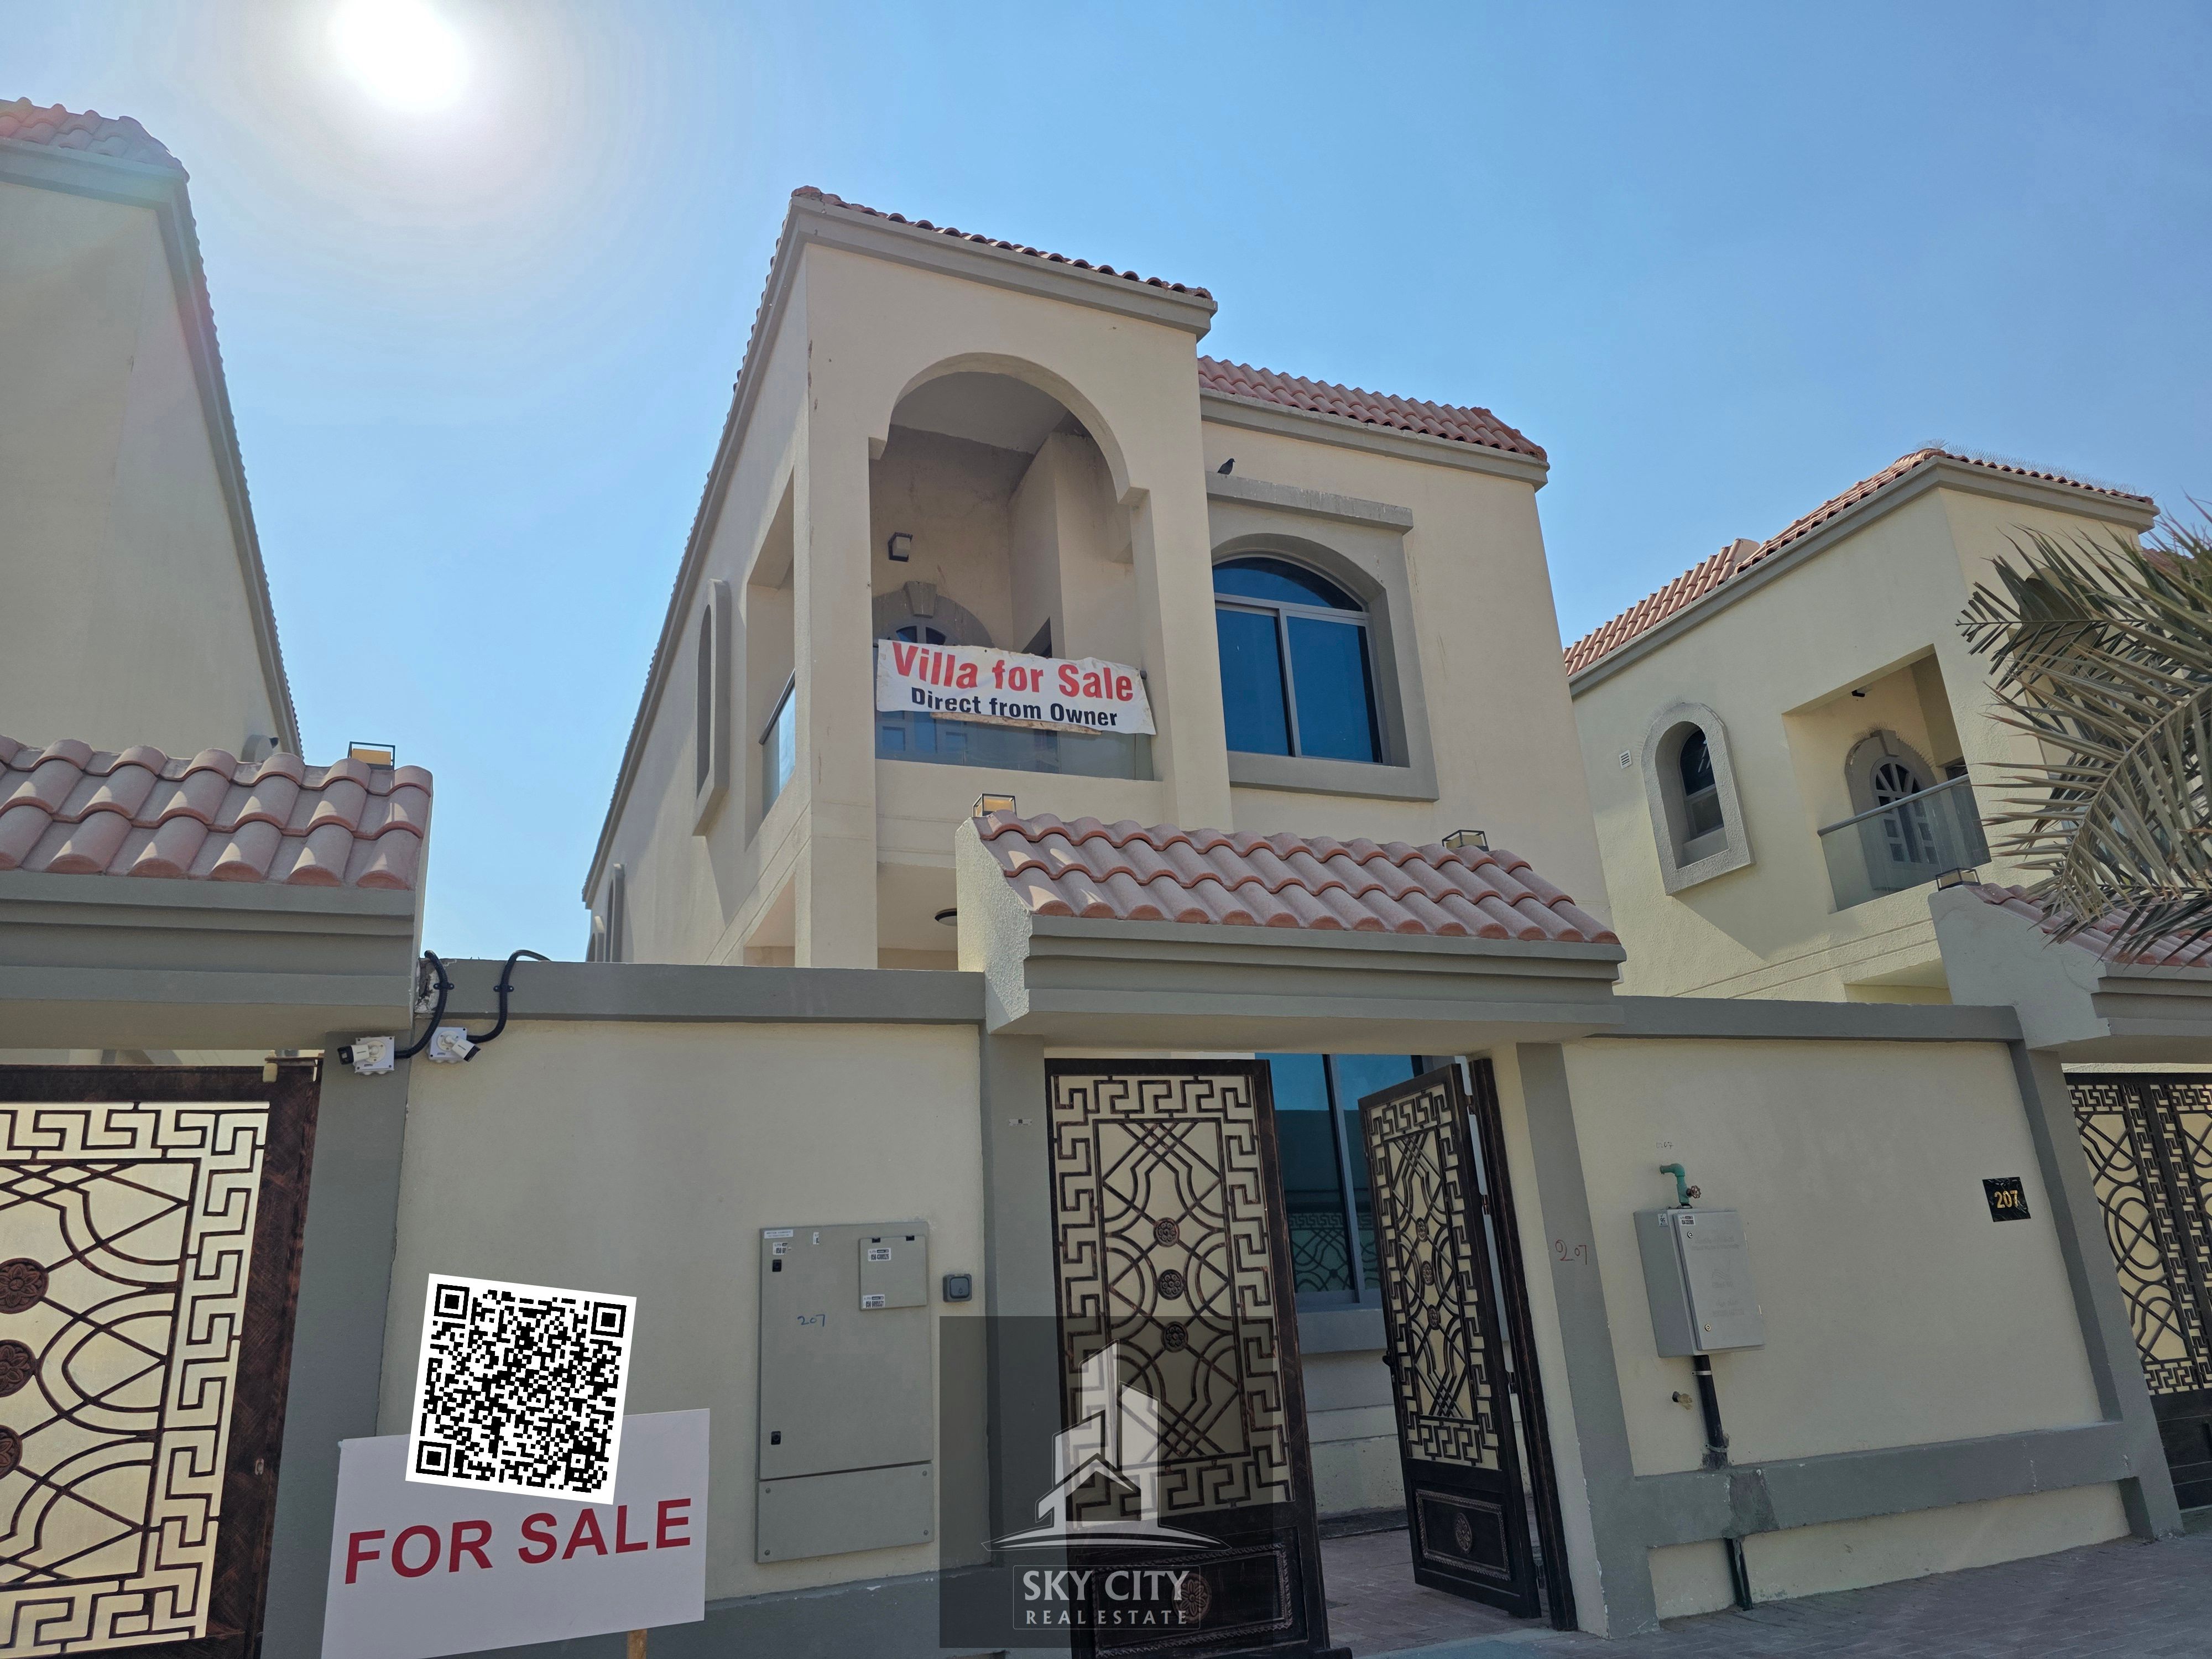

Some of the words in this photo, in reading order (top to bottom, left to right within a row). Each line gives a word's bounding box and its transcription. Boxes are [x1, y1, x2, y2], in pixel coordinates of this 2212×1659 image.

[893, 641, 978, 689] Villa
[992, 660, 1044, 693] for
[1058, 664, 1133, 701] Sale
[911, 687, 982, 714] Direct
[989, 698, 1042, 719] from
[1050, 703, 1118, 726] Owner
[1994, 1190, 2018, 1208] 207
[1554, 1239, 1587, 1265] 207
[797, 1313, 826, 1328] 207
[345, 1519, 494, 1584] FOR
[518, 1498, 691, 1564] SALE
